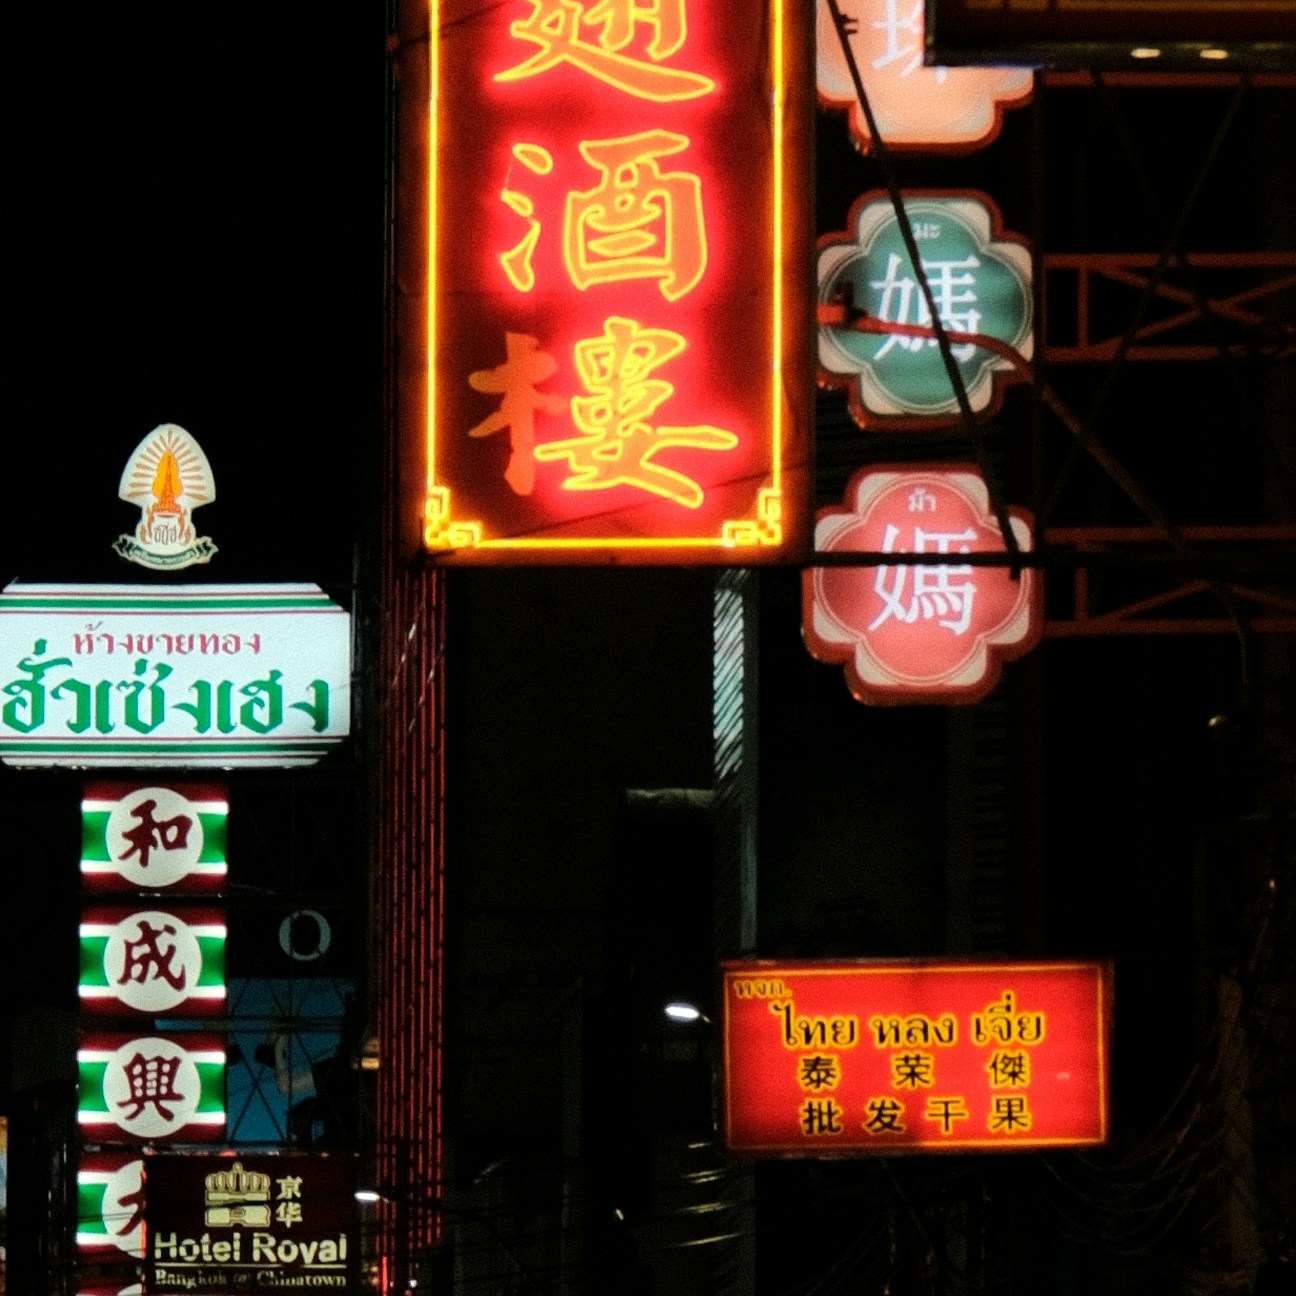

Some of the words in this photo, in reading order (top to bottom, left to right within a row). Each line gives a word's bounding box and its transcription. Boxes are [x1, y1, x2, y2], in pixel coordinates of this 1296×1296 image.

[869, 252, 981, 364] 媽
[867, 523, 978, 635] 媽
[73, 620, 261, 655] ห้างขายทอง
[2, 638, 330, 735] ฮั่วเซ่งเฮง
[770, 1001, 858, 1049] ไทย
[870, 1013, 959, 1048] หลง
[801, 1096, 1032, 1137] 批发干果
[154, 1231, 242, 1262] Hotel
[252, 1232, 348, 1265] Royal
[255, 1269, 348, 1288] Chinatown
